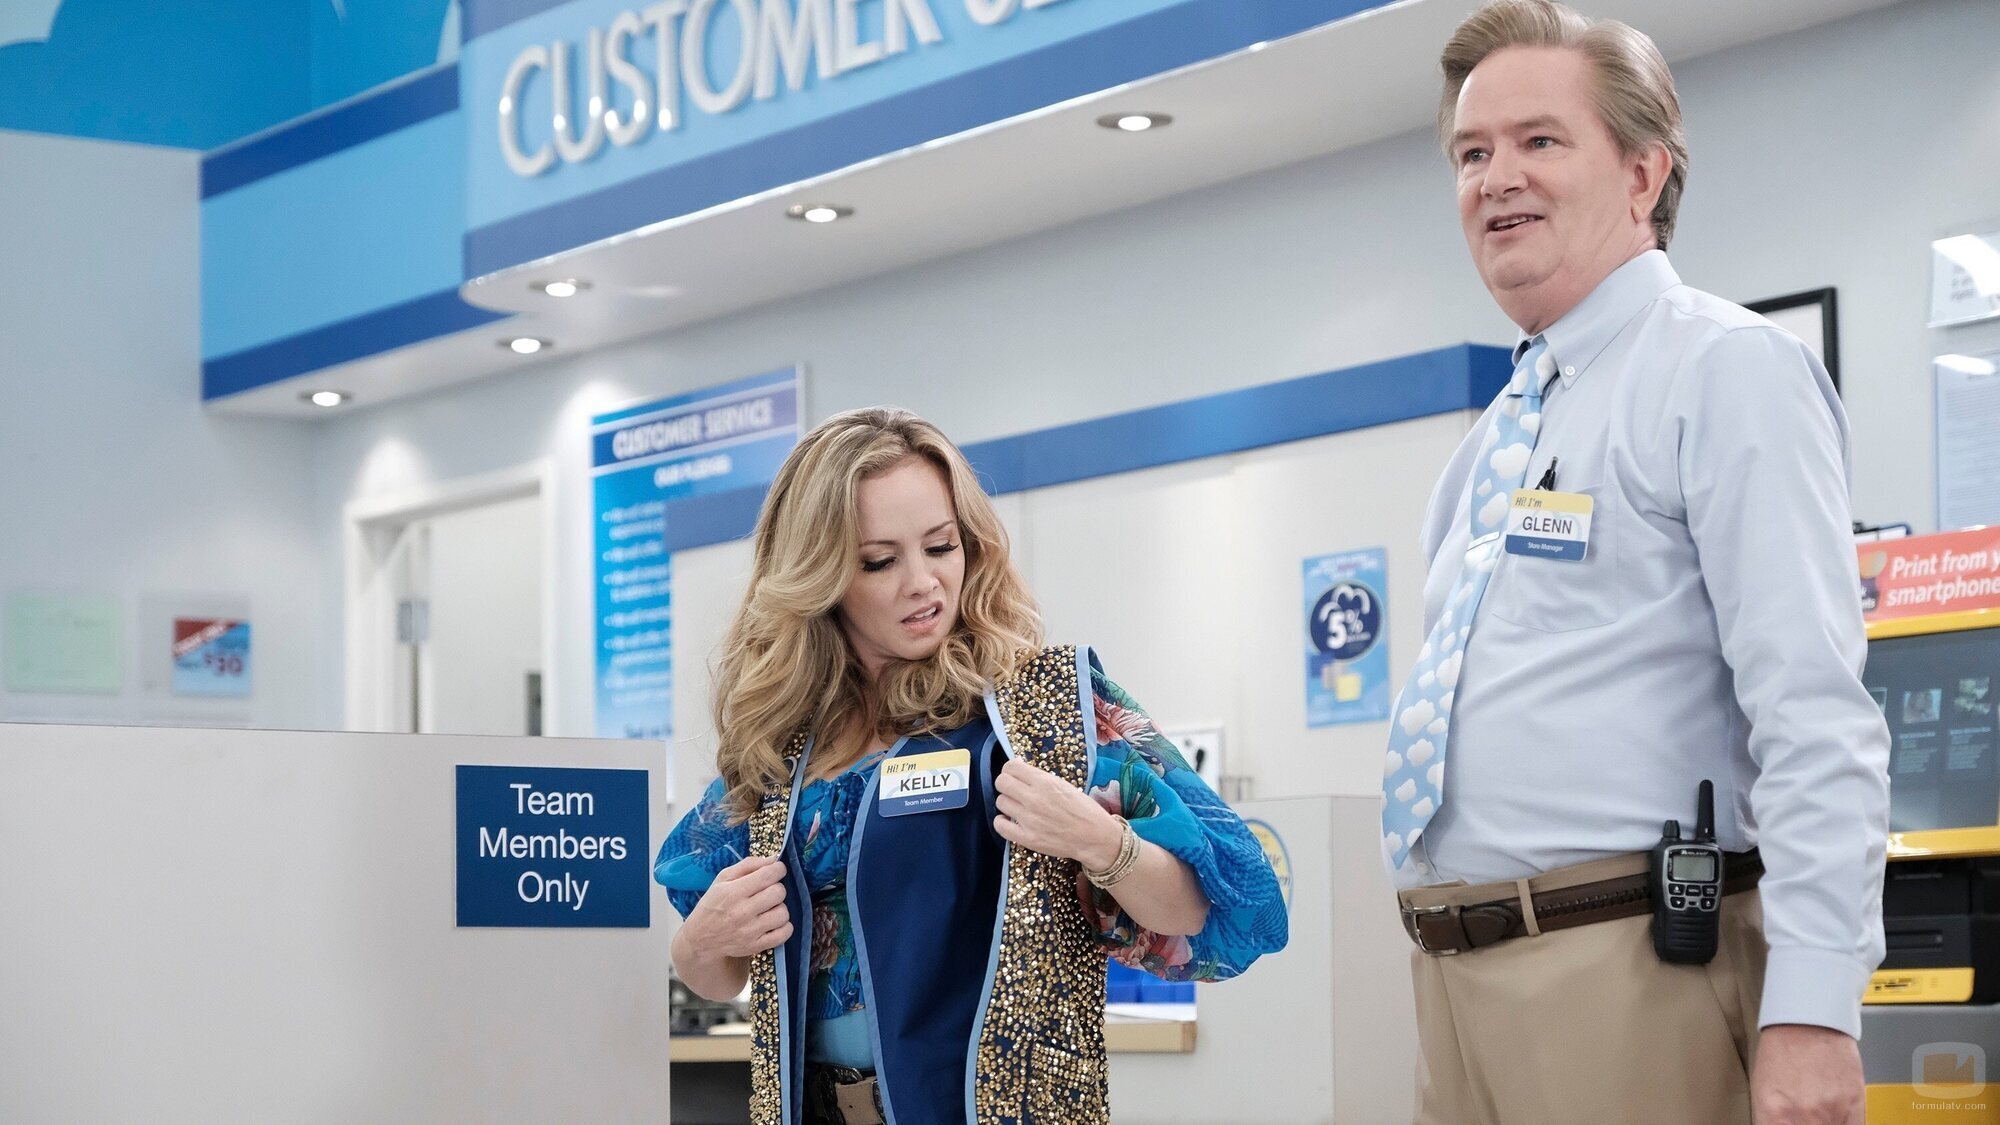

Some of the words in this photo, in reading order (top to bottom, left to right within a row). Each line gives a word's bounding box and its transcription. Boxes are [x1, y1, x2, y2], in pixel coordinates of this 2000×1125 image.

[1522, 516, 1572, 535] GLENN
[1527, 541, 1540, 550] Store
[1541, 542, 1564, 553] Manager
[1891, 553, 1937, 580] Print
[1942, 549, 1987, 573] from
[1886, 576, 2000, 607] smartphone
[886, 764, 899, 774] Hi!
[901, 762, 917, 772] I'm
[900, 773, 951, 792] KELLY
[509, 783, 594, 816] Team
[904, 799, 919, 807] Team
[920, 796, 944, 805] Member
[479, 826, 627, 860] Members
[517, 870, 590, 911] Only
